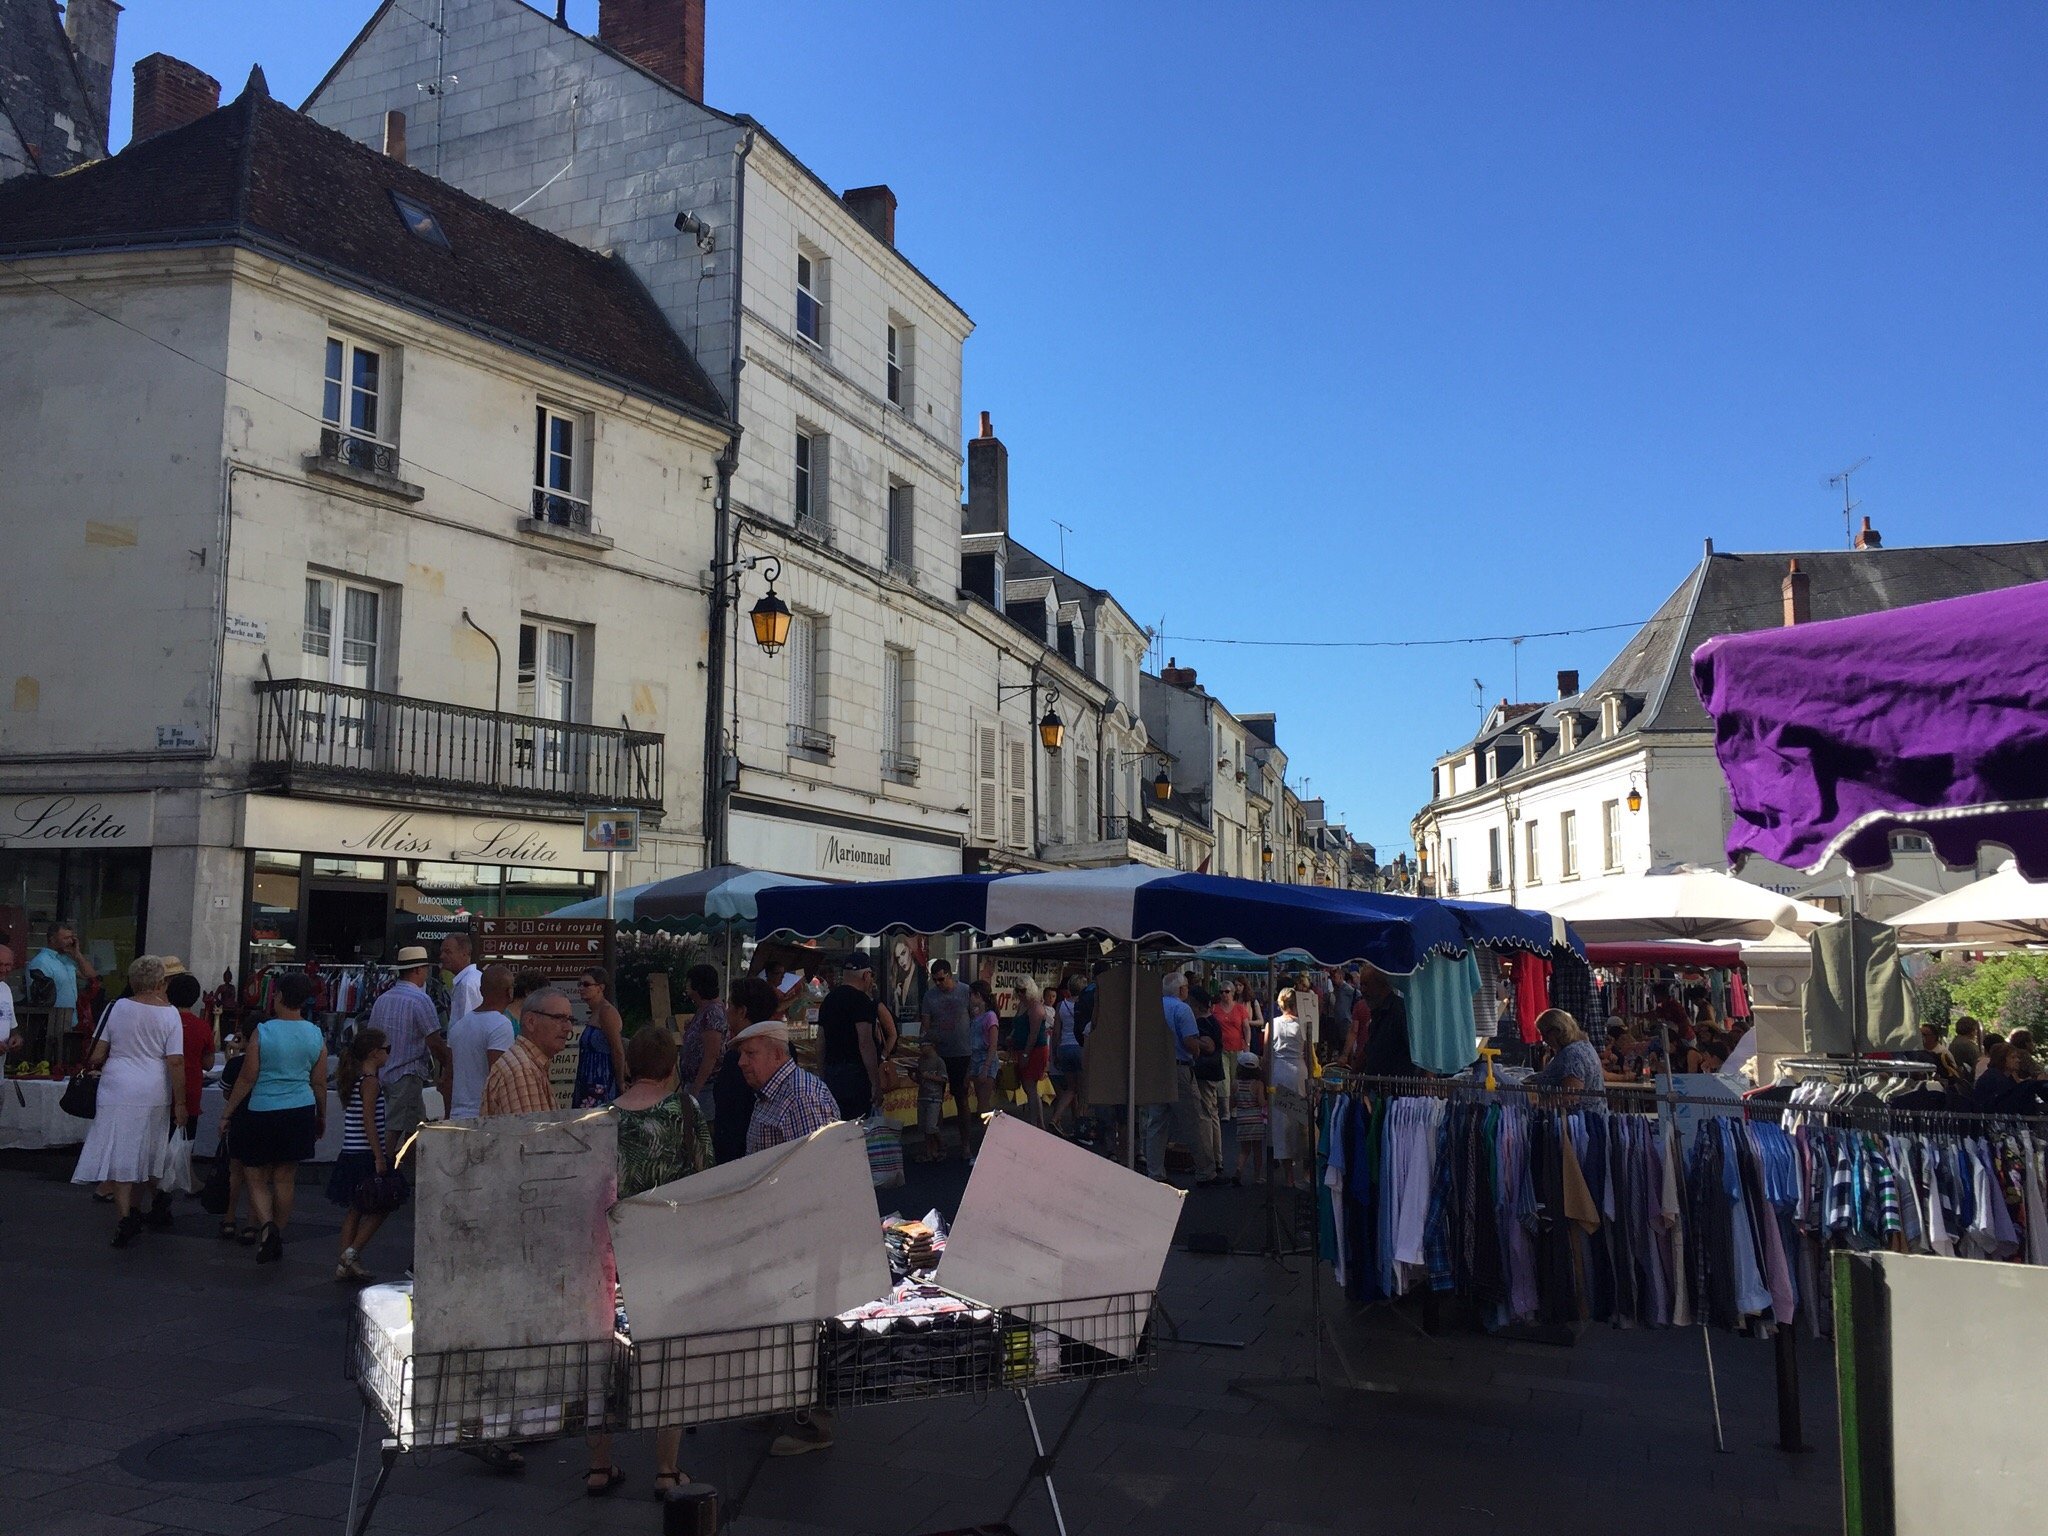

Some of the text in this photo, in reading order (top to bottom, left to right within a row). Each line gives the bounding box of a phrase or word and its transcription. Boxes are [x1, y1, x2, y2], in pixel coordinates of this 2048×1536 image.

[0, 796, 126, 839] Lolita
[341, 812, 559, 861] Miss Lolita
[822, 835, 891, 869] Marionnaud
[416, 896, 462, 906] MAROQUINERIE
[416, 914, 469, 922] CHAUSSURES FEM
[538, 920, 602, 934] Cité royale
[416, 932, 449, 940] ACCESSOIR
[500, 941, 580, 951] Hôtel de Ville
[556, 964, 589, 973] histori
[550, 1067, 576, 1075] CHÂTEA
